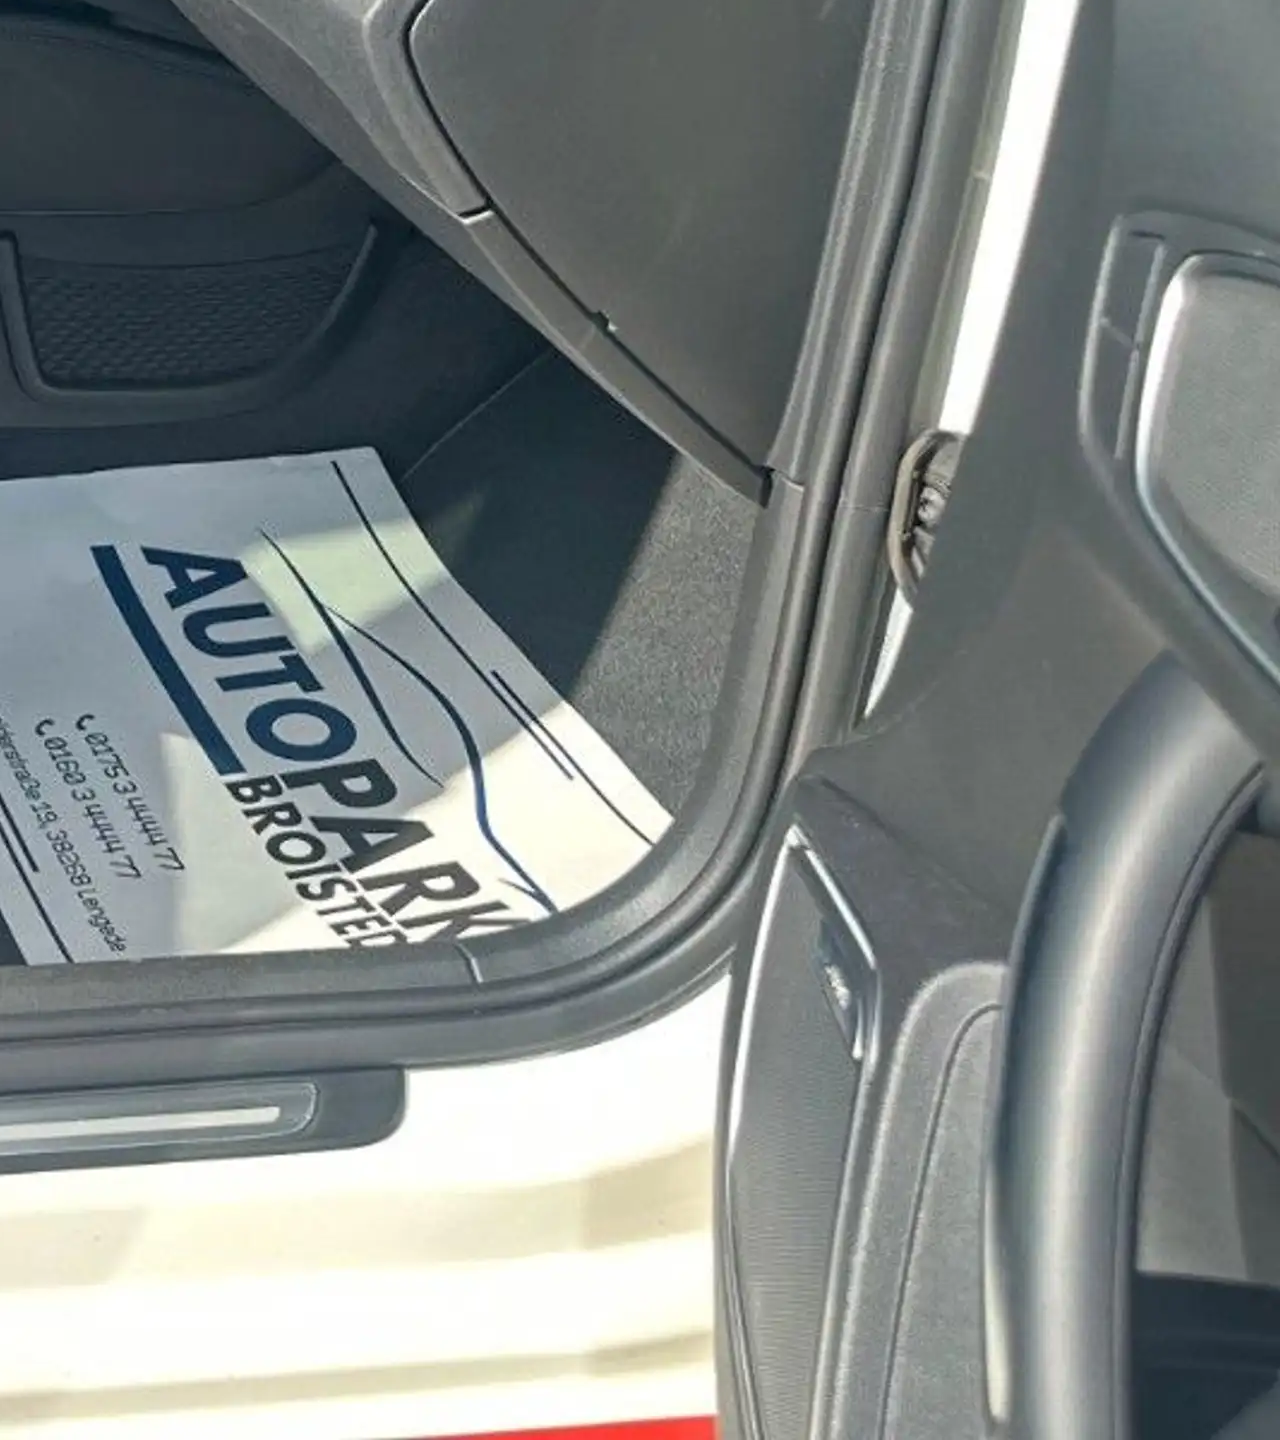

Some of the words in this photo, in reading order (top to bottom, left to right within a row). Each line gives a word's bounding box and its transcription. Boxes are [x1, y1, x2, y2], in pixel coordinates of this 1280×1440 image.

[44, 736, 87, 786] 0160
[71, 787, 96, 802] 3
[85, 803, 125, 854] 4444
[109, 855, 142, 878] 77
[85, 731, 129, 780] 0175
[113, 782, 138, 797] 3
[127, 797, 169, 847] 4444
[153, 847, 185, 871] 77
[139, 544, 533, 944] AUTOPARK
[46, 829, 92, 886] 38268
[78, 887, 127, 954] Lengede
